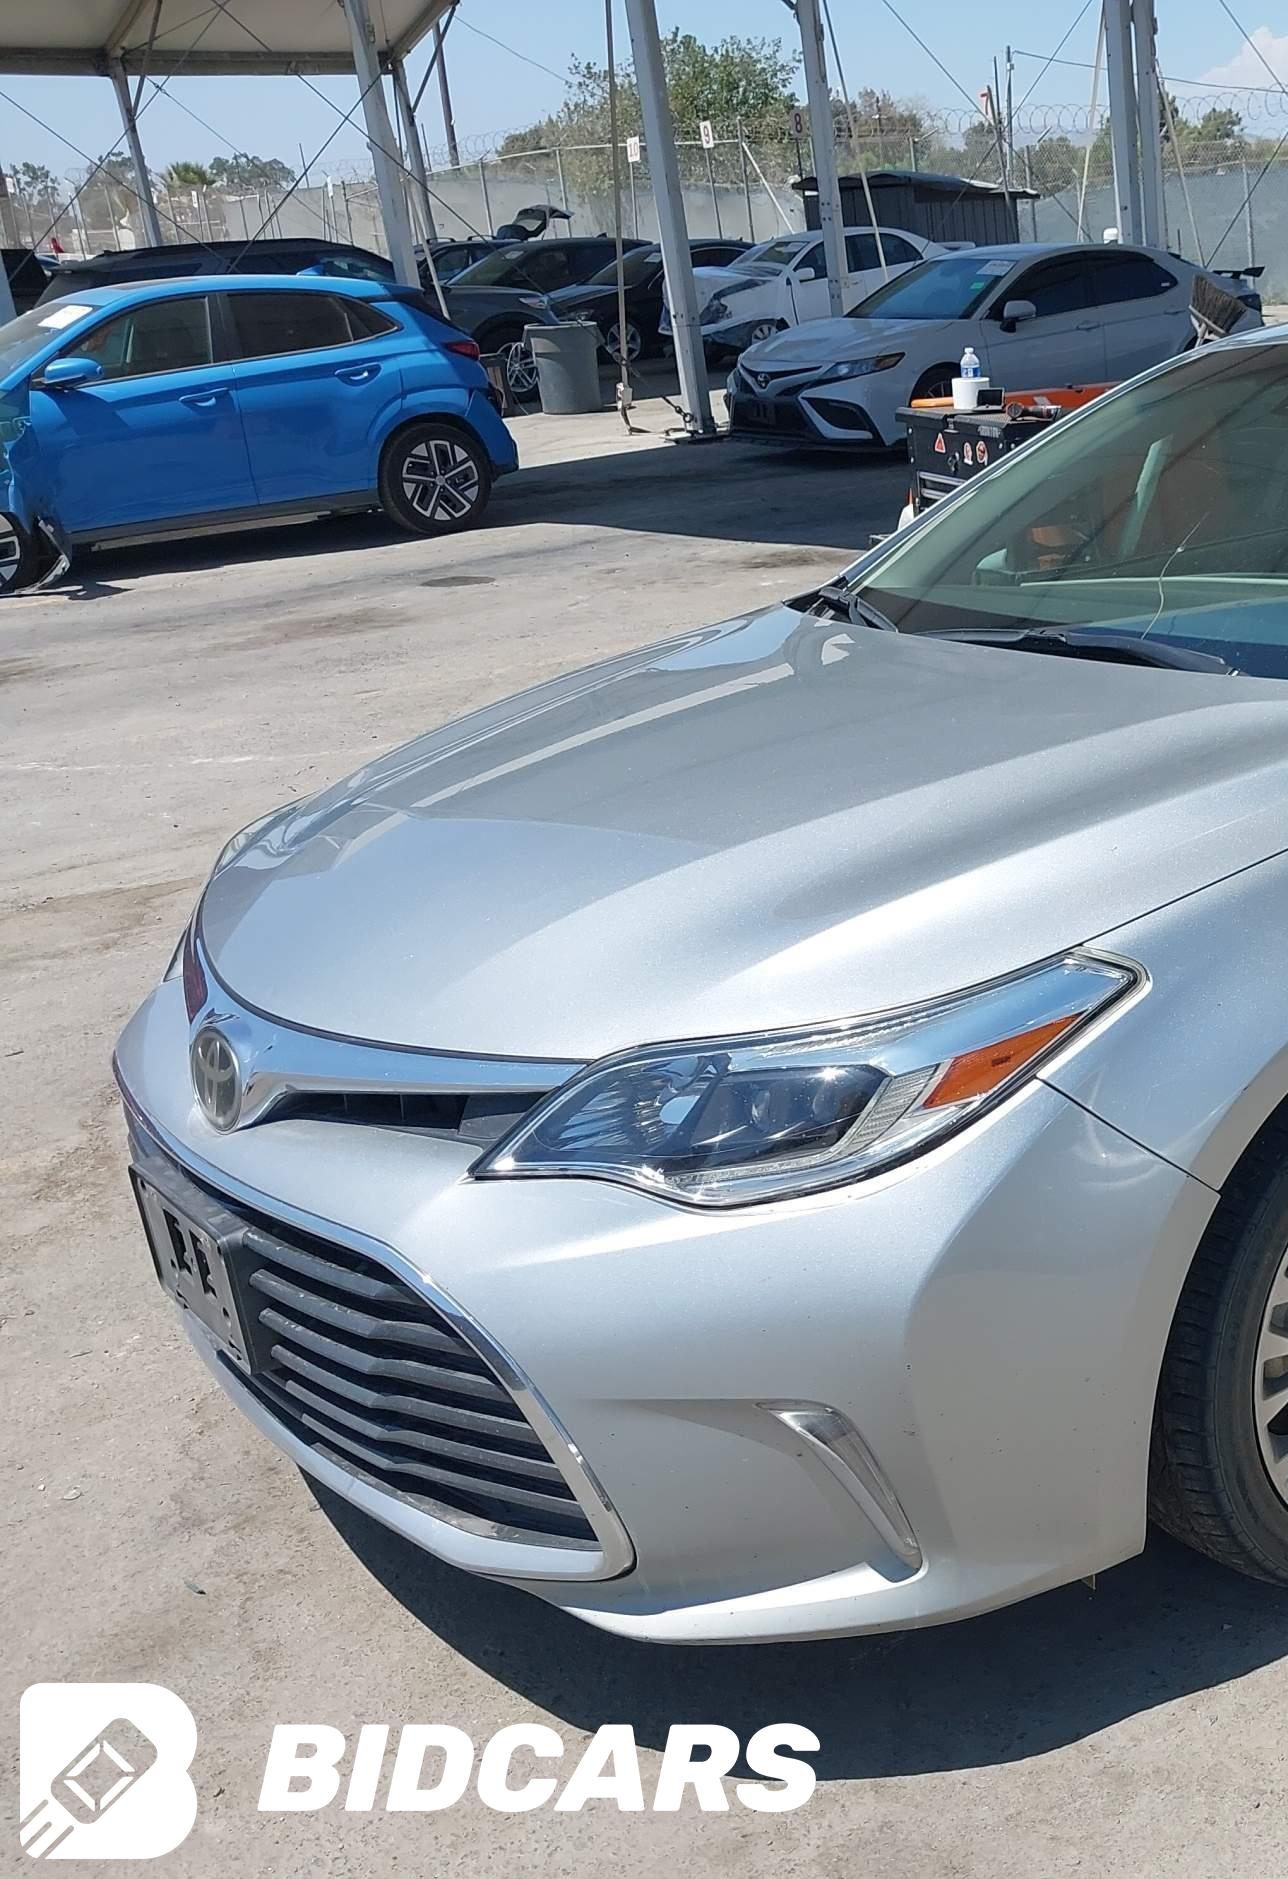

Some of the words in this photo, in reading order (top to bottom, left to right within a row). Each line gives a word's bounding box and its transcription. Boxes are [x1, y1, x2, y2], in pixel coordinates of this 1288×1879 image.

[794, 112, 803, 133] 8
[703, 125, 711, 144] 9
[628, 142, 639, 157] 10
